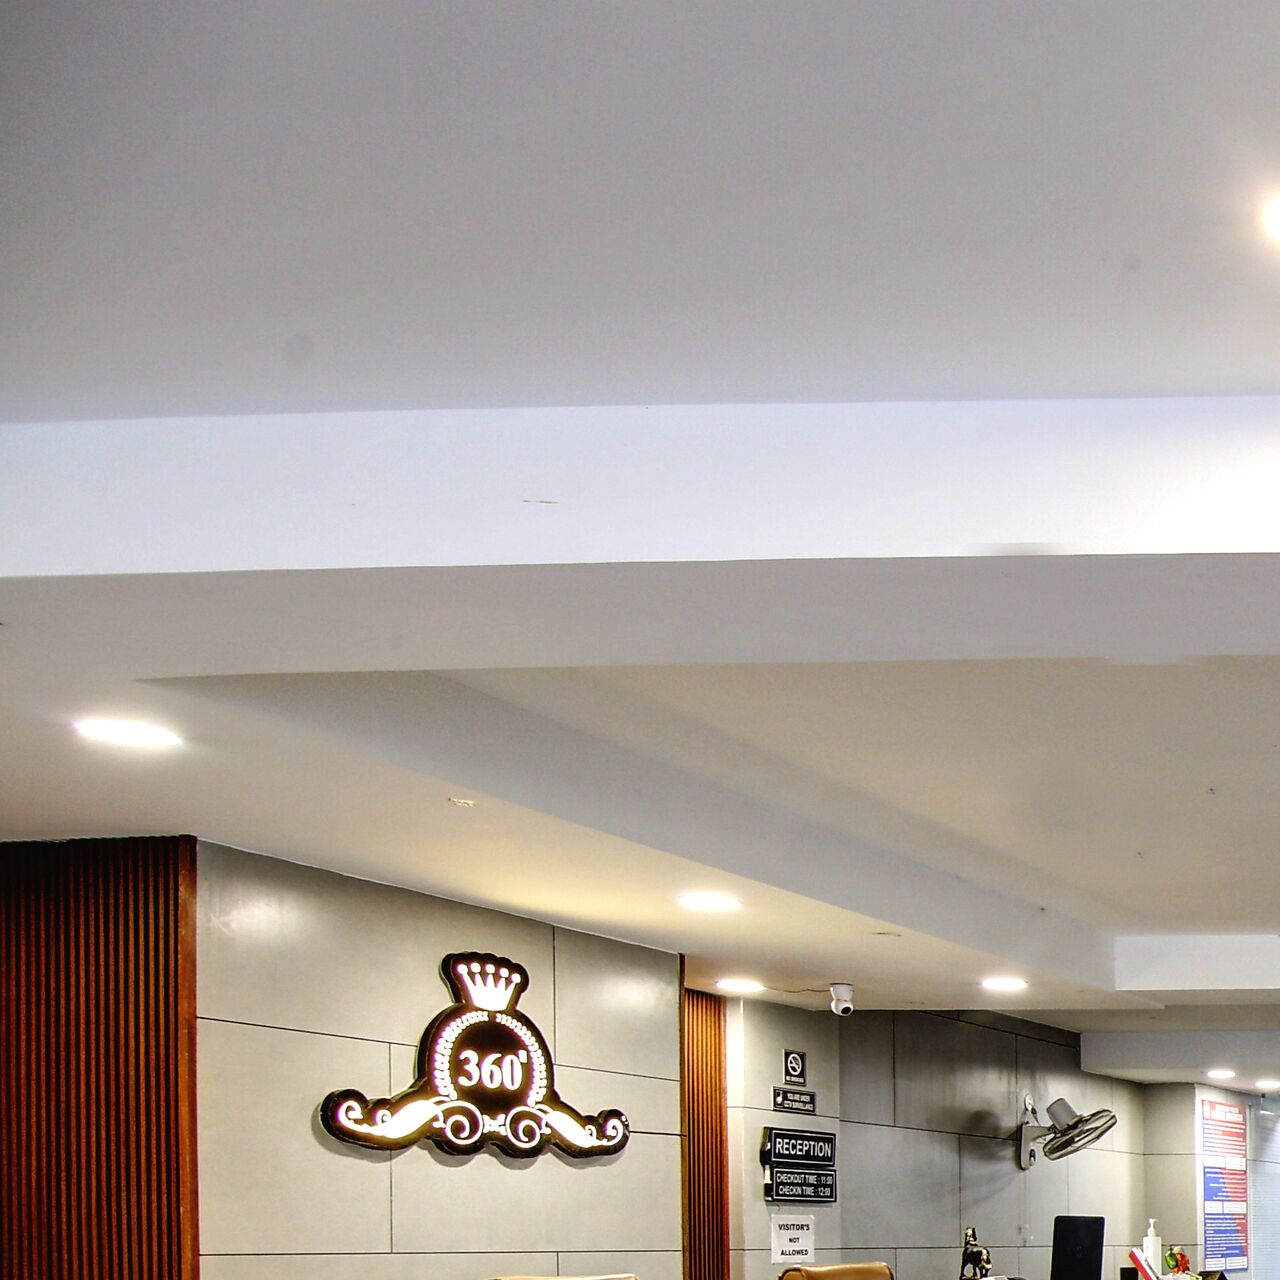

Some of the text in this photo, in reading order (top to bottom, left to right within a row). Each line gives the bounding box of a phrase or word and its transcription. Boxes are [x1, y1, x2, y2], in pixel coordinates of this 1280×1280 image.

[776, 1138, 831, 1157] RECEPTION
[777, 1173, 804, 1183] CHECKOUT
[805, 1174, 817, 1184] TIME
[779, 1185, 802, 1195] CHECKIN
[802, 1186, 815, 1196] TIME
